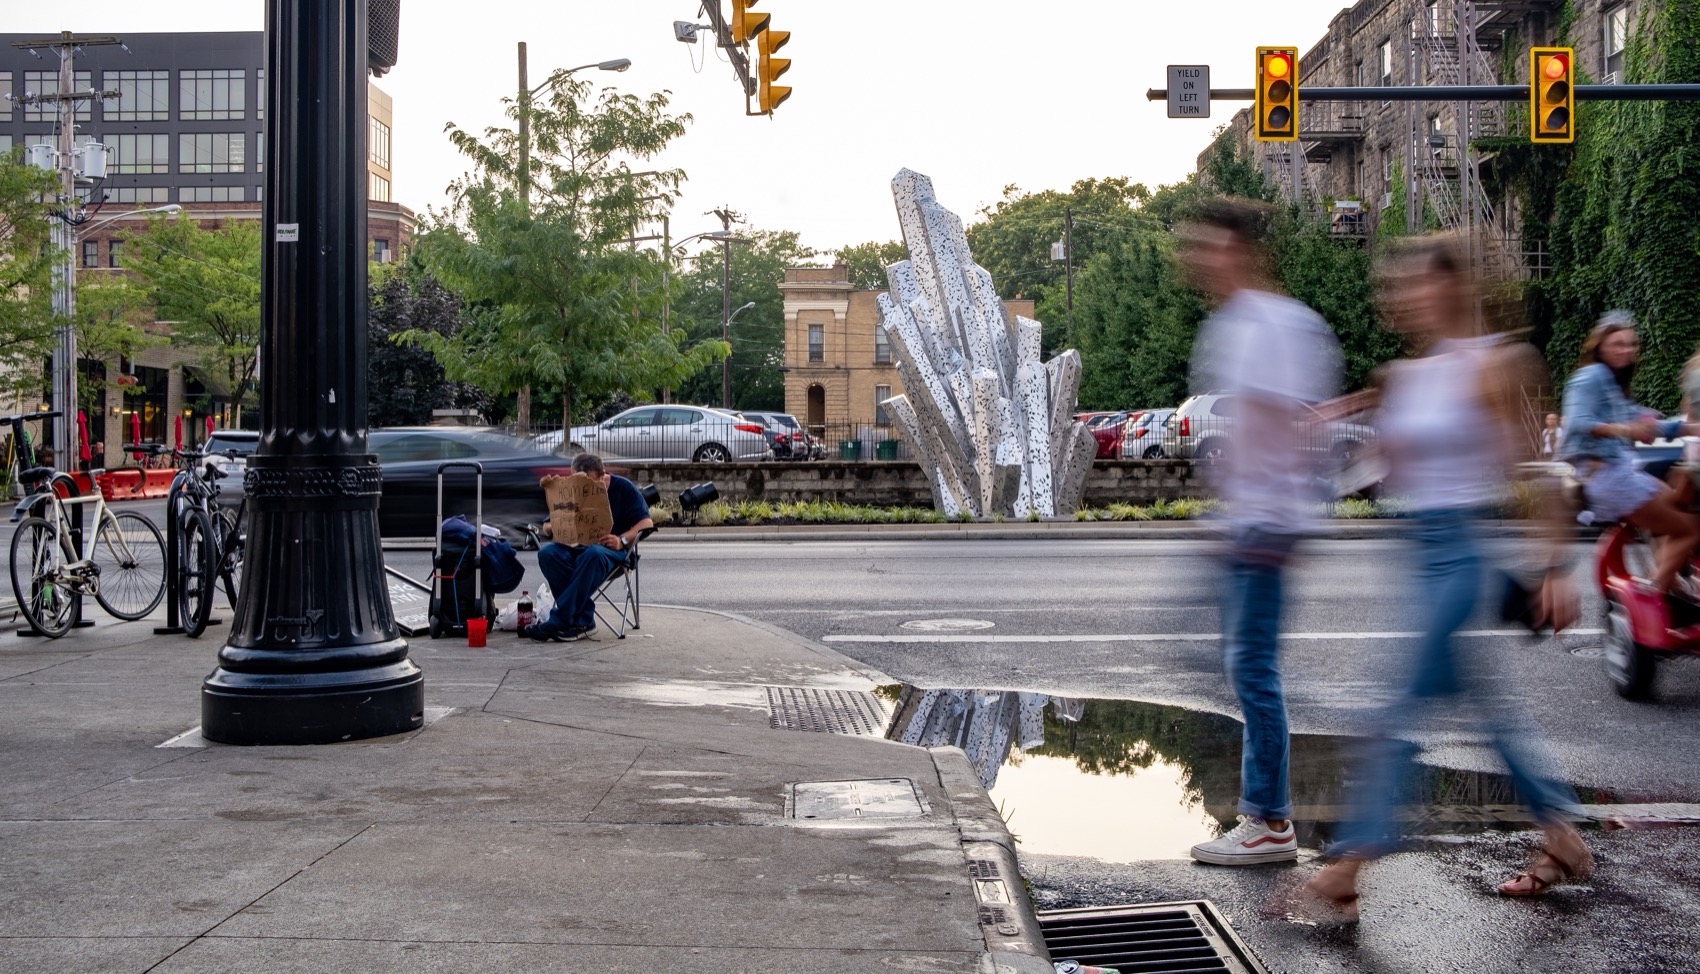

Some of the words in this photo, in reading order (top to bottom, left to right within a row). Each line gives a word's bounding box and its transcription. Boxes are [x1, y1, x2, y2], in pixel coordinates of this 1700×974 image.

[1177, 69, 1200, 78] YIELD
[1183, 81, 1194, 90] ON
[1179, 93, 1198, 102] LEFT
[1179, 105, 1200, 114] TURN
[557, 528, 584, 540] HELP
